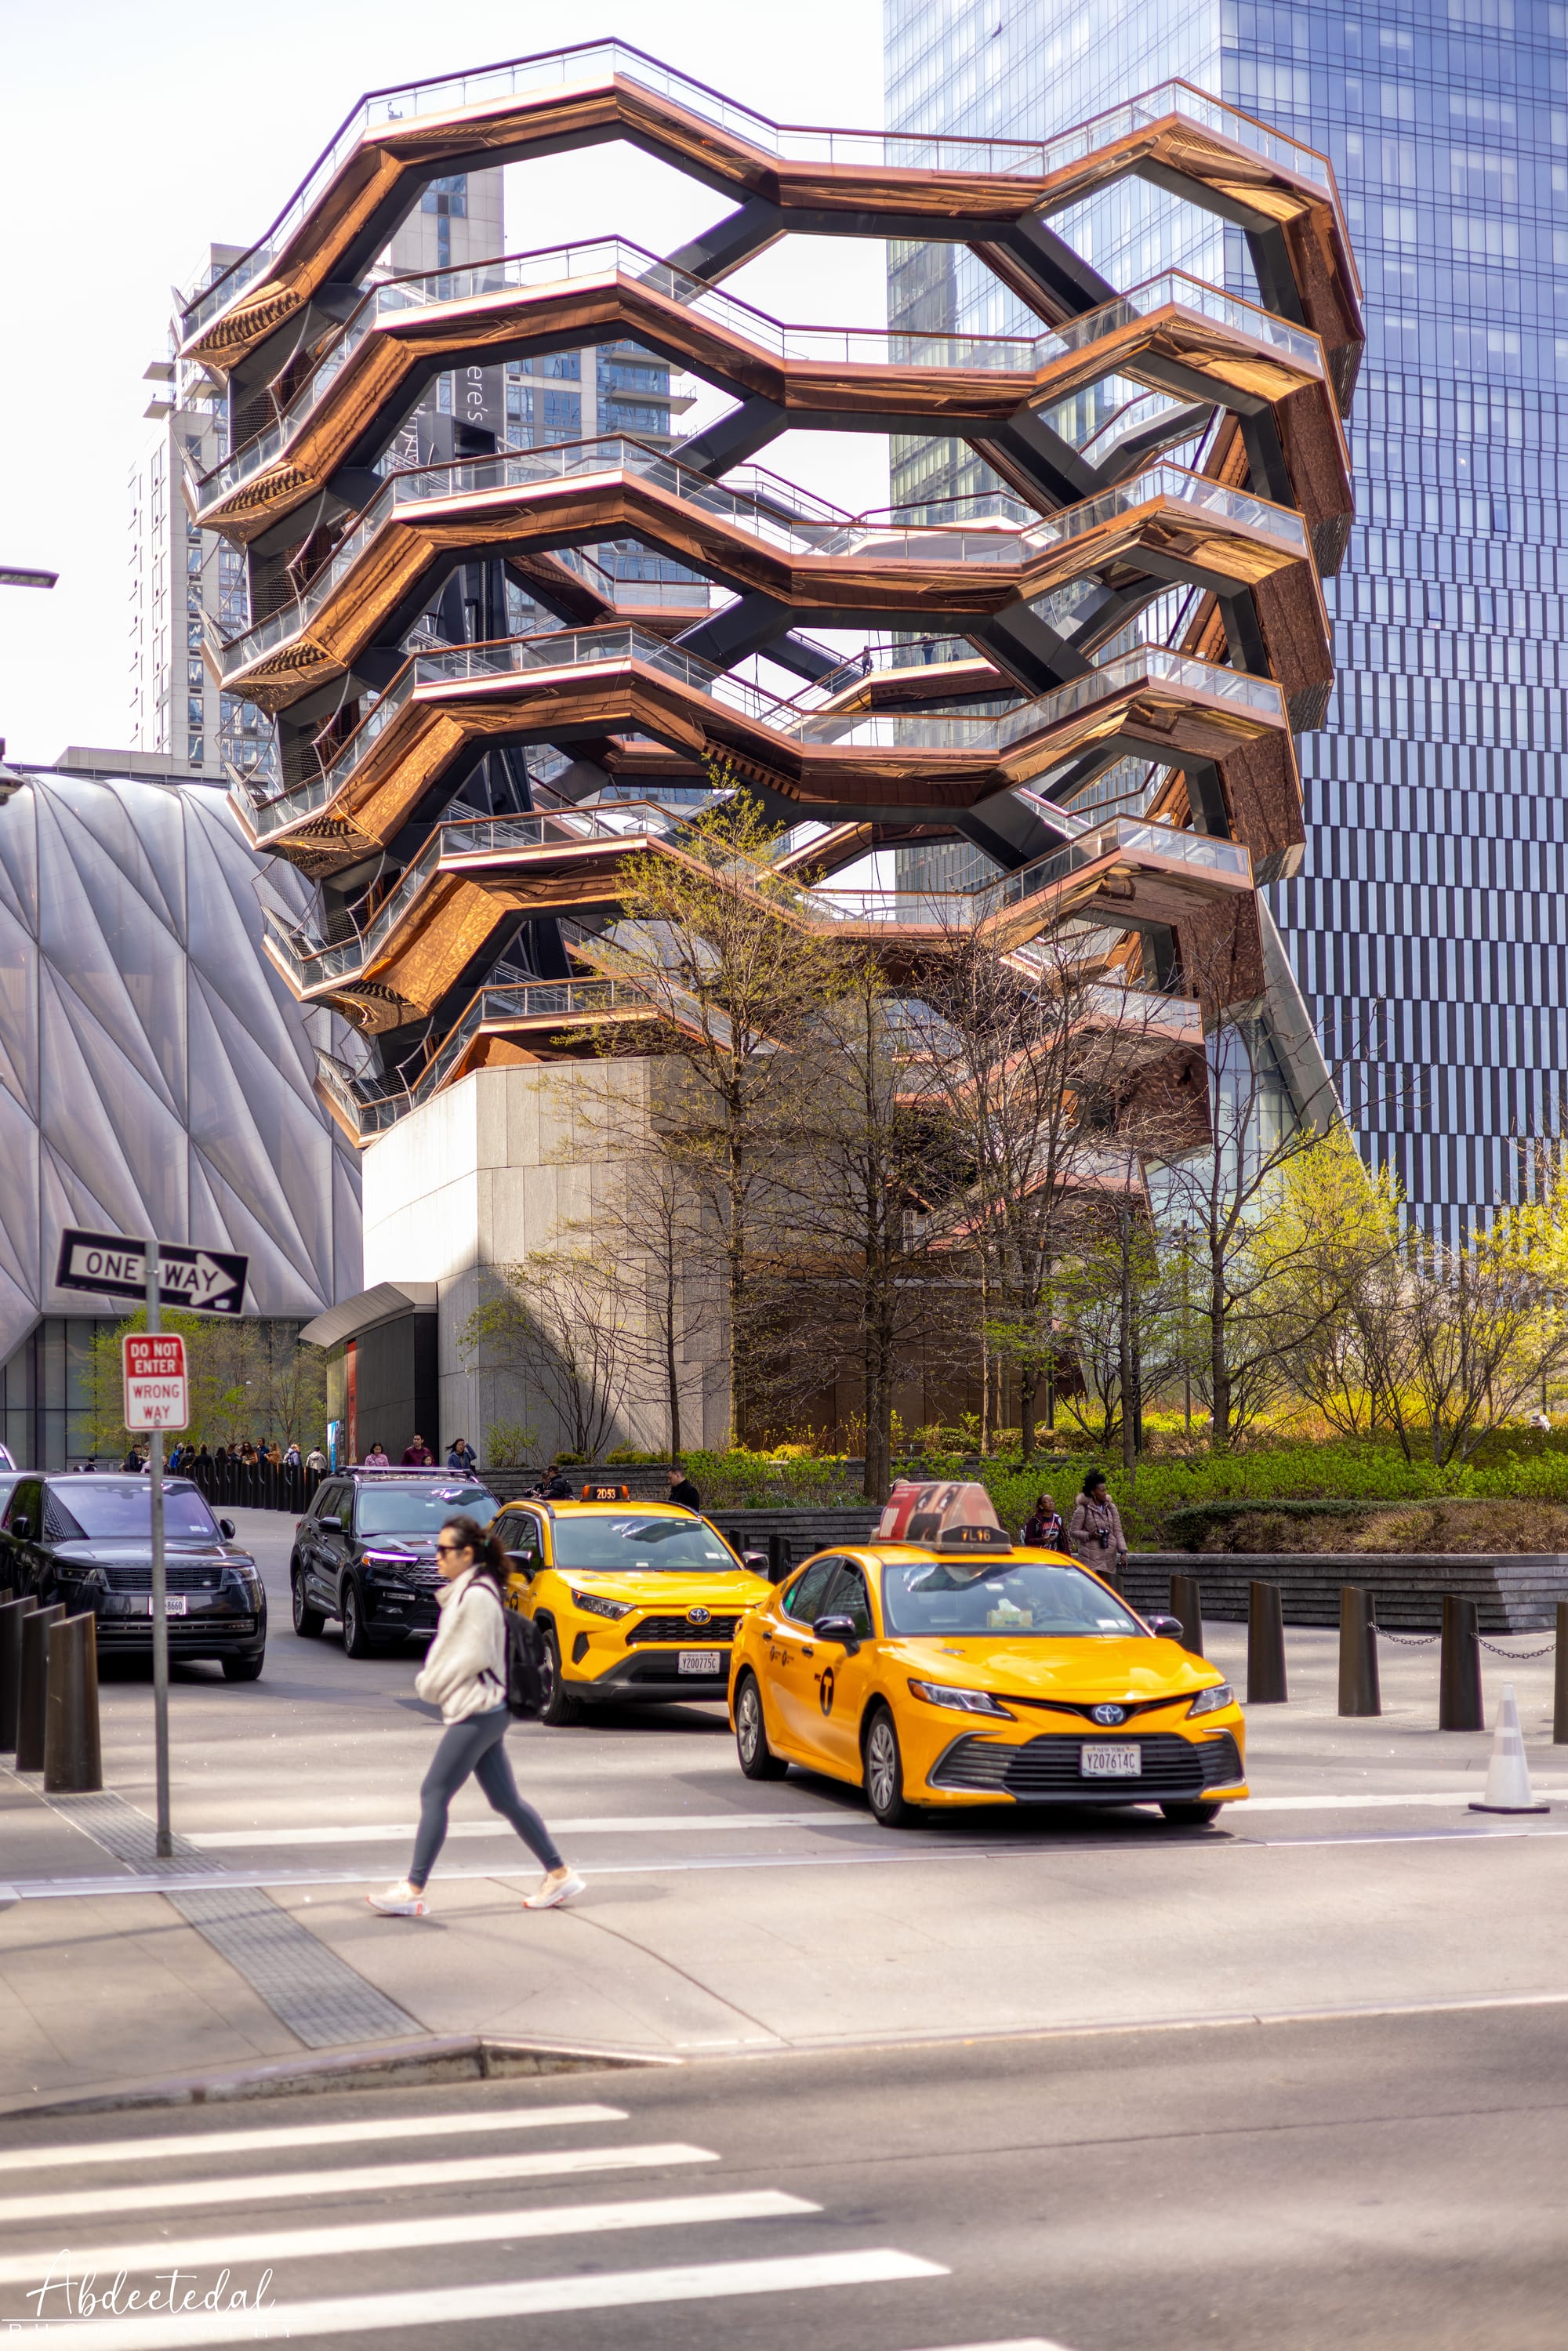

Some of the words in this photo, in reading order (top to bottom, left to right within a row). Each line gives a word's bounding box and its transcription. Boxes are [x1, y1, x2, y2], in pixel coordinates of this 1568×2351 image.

[85, 1251, 140, 1281] ONE
[164, 1263, 219, 1293] WAY
[130, 1343, 149, 1358] DO
[153, 1341, 179, 1357] NOT
[135, 1359, 176, 1374] ENTER
[132, 1384, 180, 1399] WRONG
[143, 1405, 170, 1420] WAY
[597, 1488, 616, 1500] 2D53
[962, 1529, 991, 1542] 7L16
[682, 1657, 717, 1669] Y200775C
[1087, 1752, 1135, 1769] Y207614C
